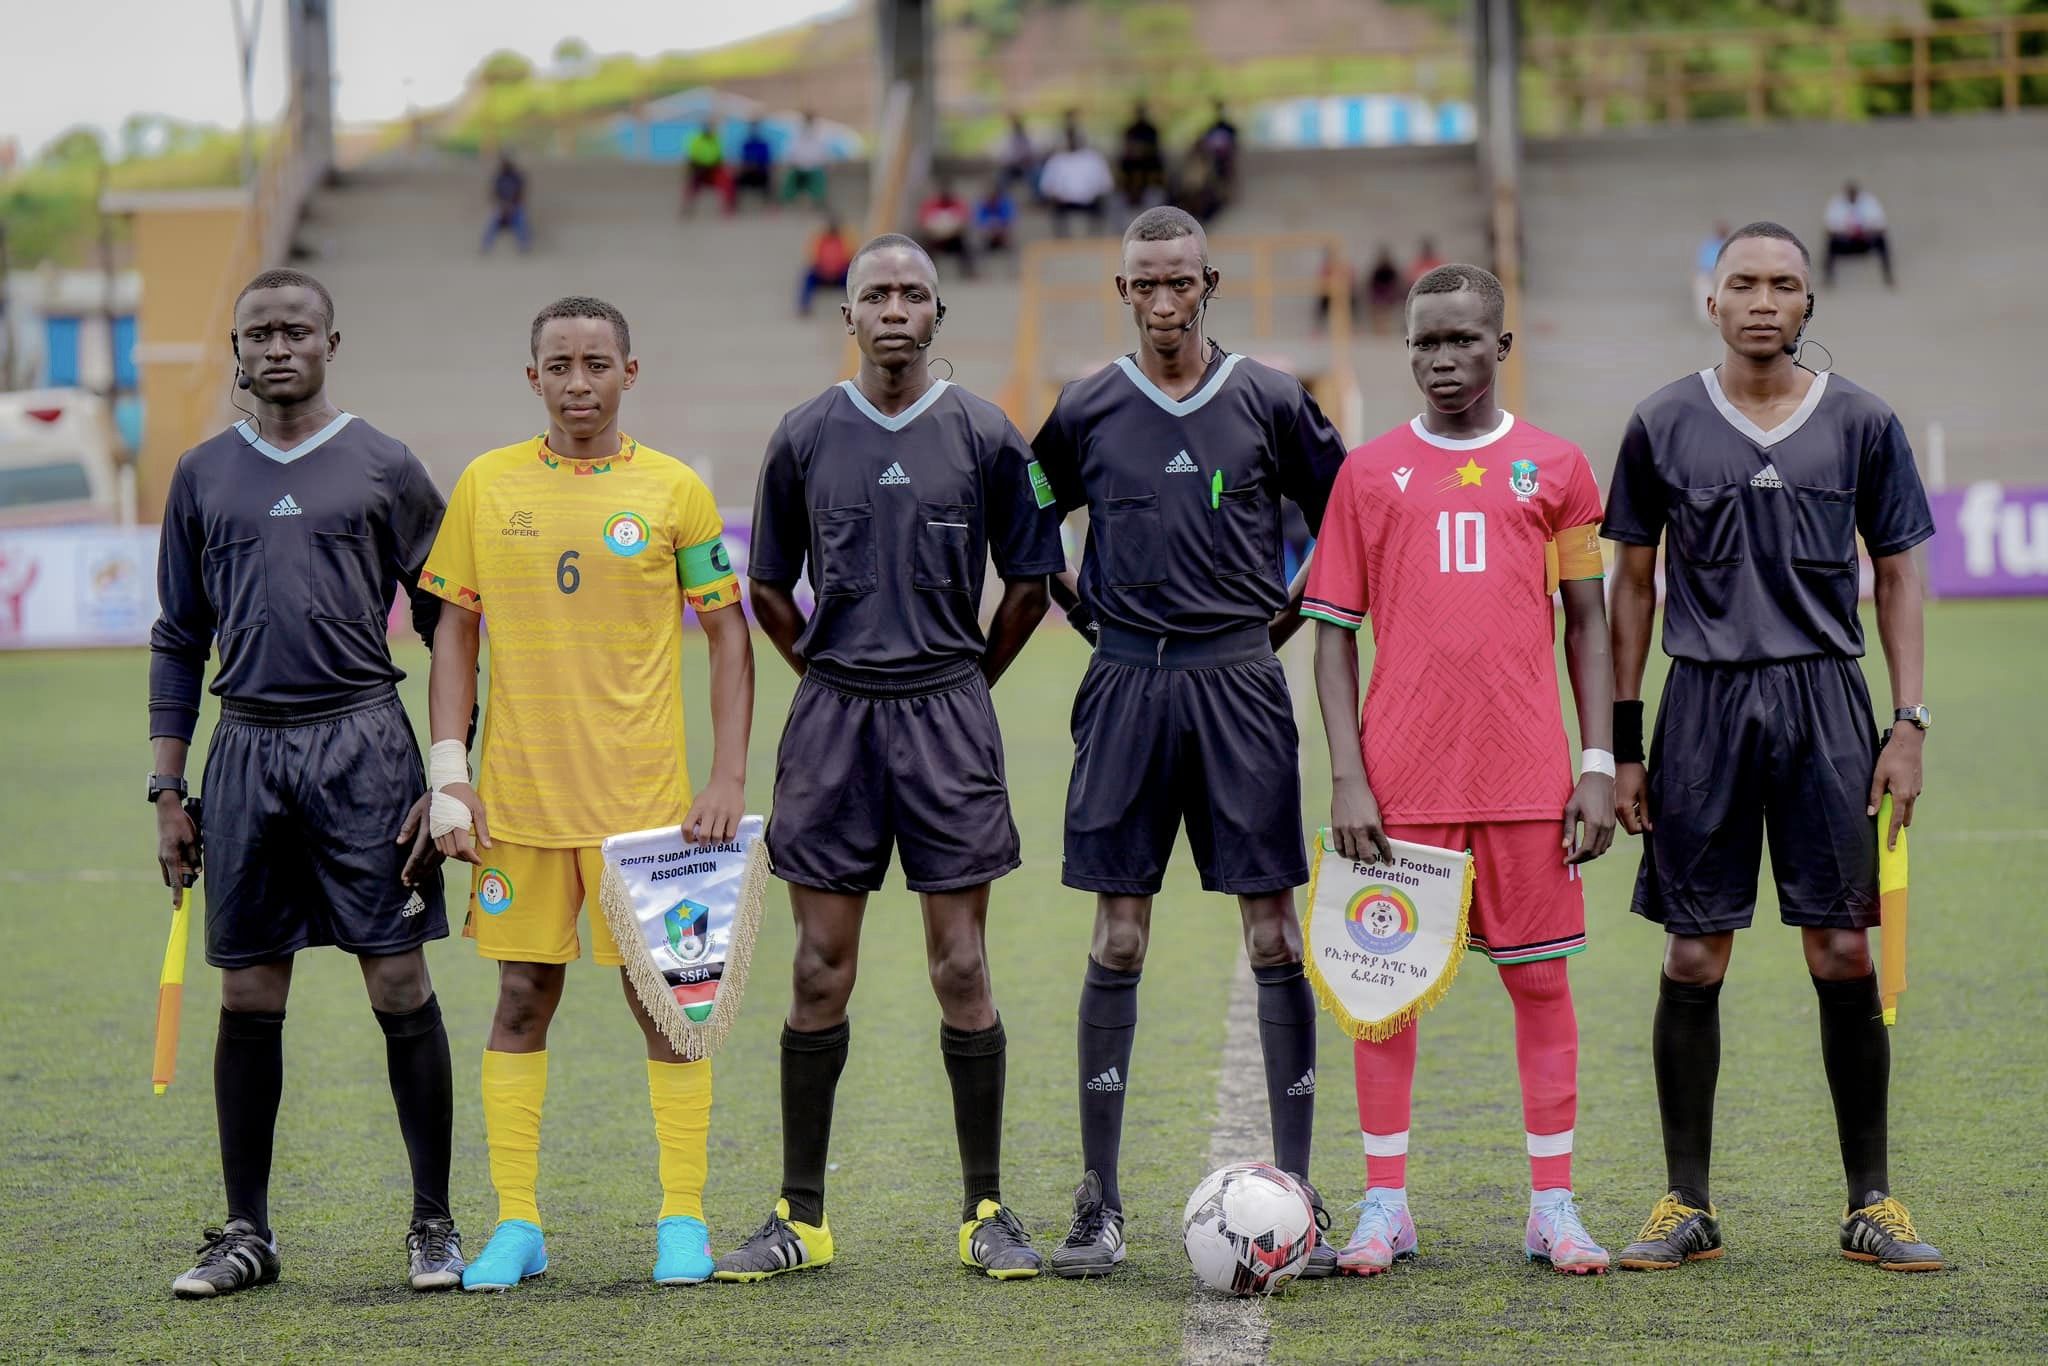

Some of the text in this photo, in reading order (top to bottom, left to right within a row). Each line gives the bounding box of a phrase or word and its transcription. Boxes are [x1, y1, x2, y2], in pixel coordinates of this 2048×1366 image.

[1165, 464, 1198, 473] adidas
[879, 476, 910, 485] adidas
[1751, 479, 1783, 489] adidas
[270, 507, 302, 517] adidas
[501, 529, 540, 537] GOFERE
[1436, 511, 1486, 573] 10
[556, 550, 580, 595] 6
[620, 855, 655, 866] SOUTH
[658, 849, 691, 863] SUDAN
[650, 861, 717, 882] ASSOCIATION
[1352, 863, 1420, 887] Federation
[1400, 858, 1451, 879] Football
[680, 967, 710, 983] SSFA
[1087, 1081, 1124, 1092] adidas
